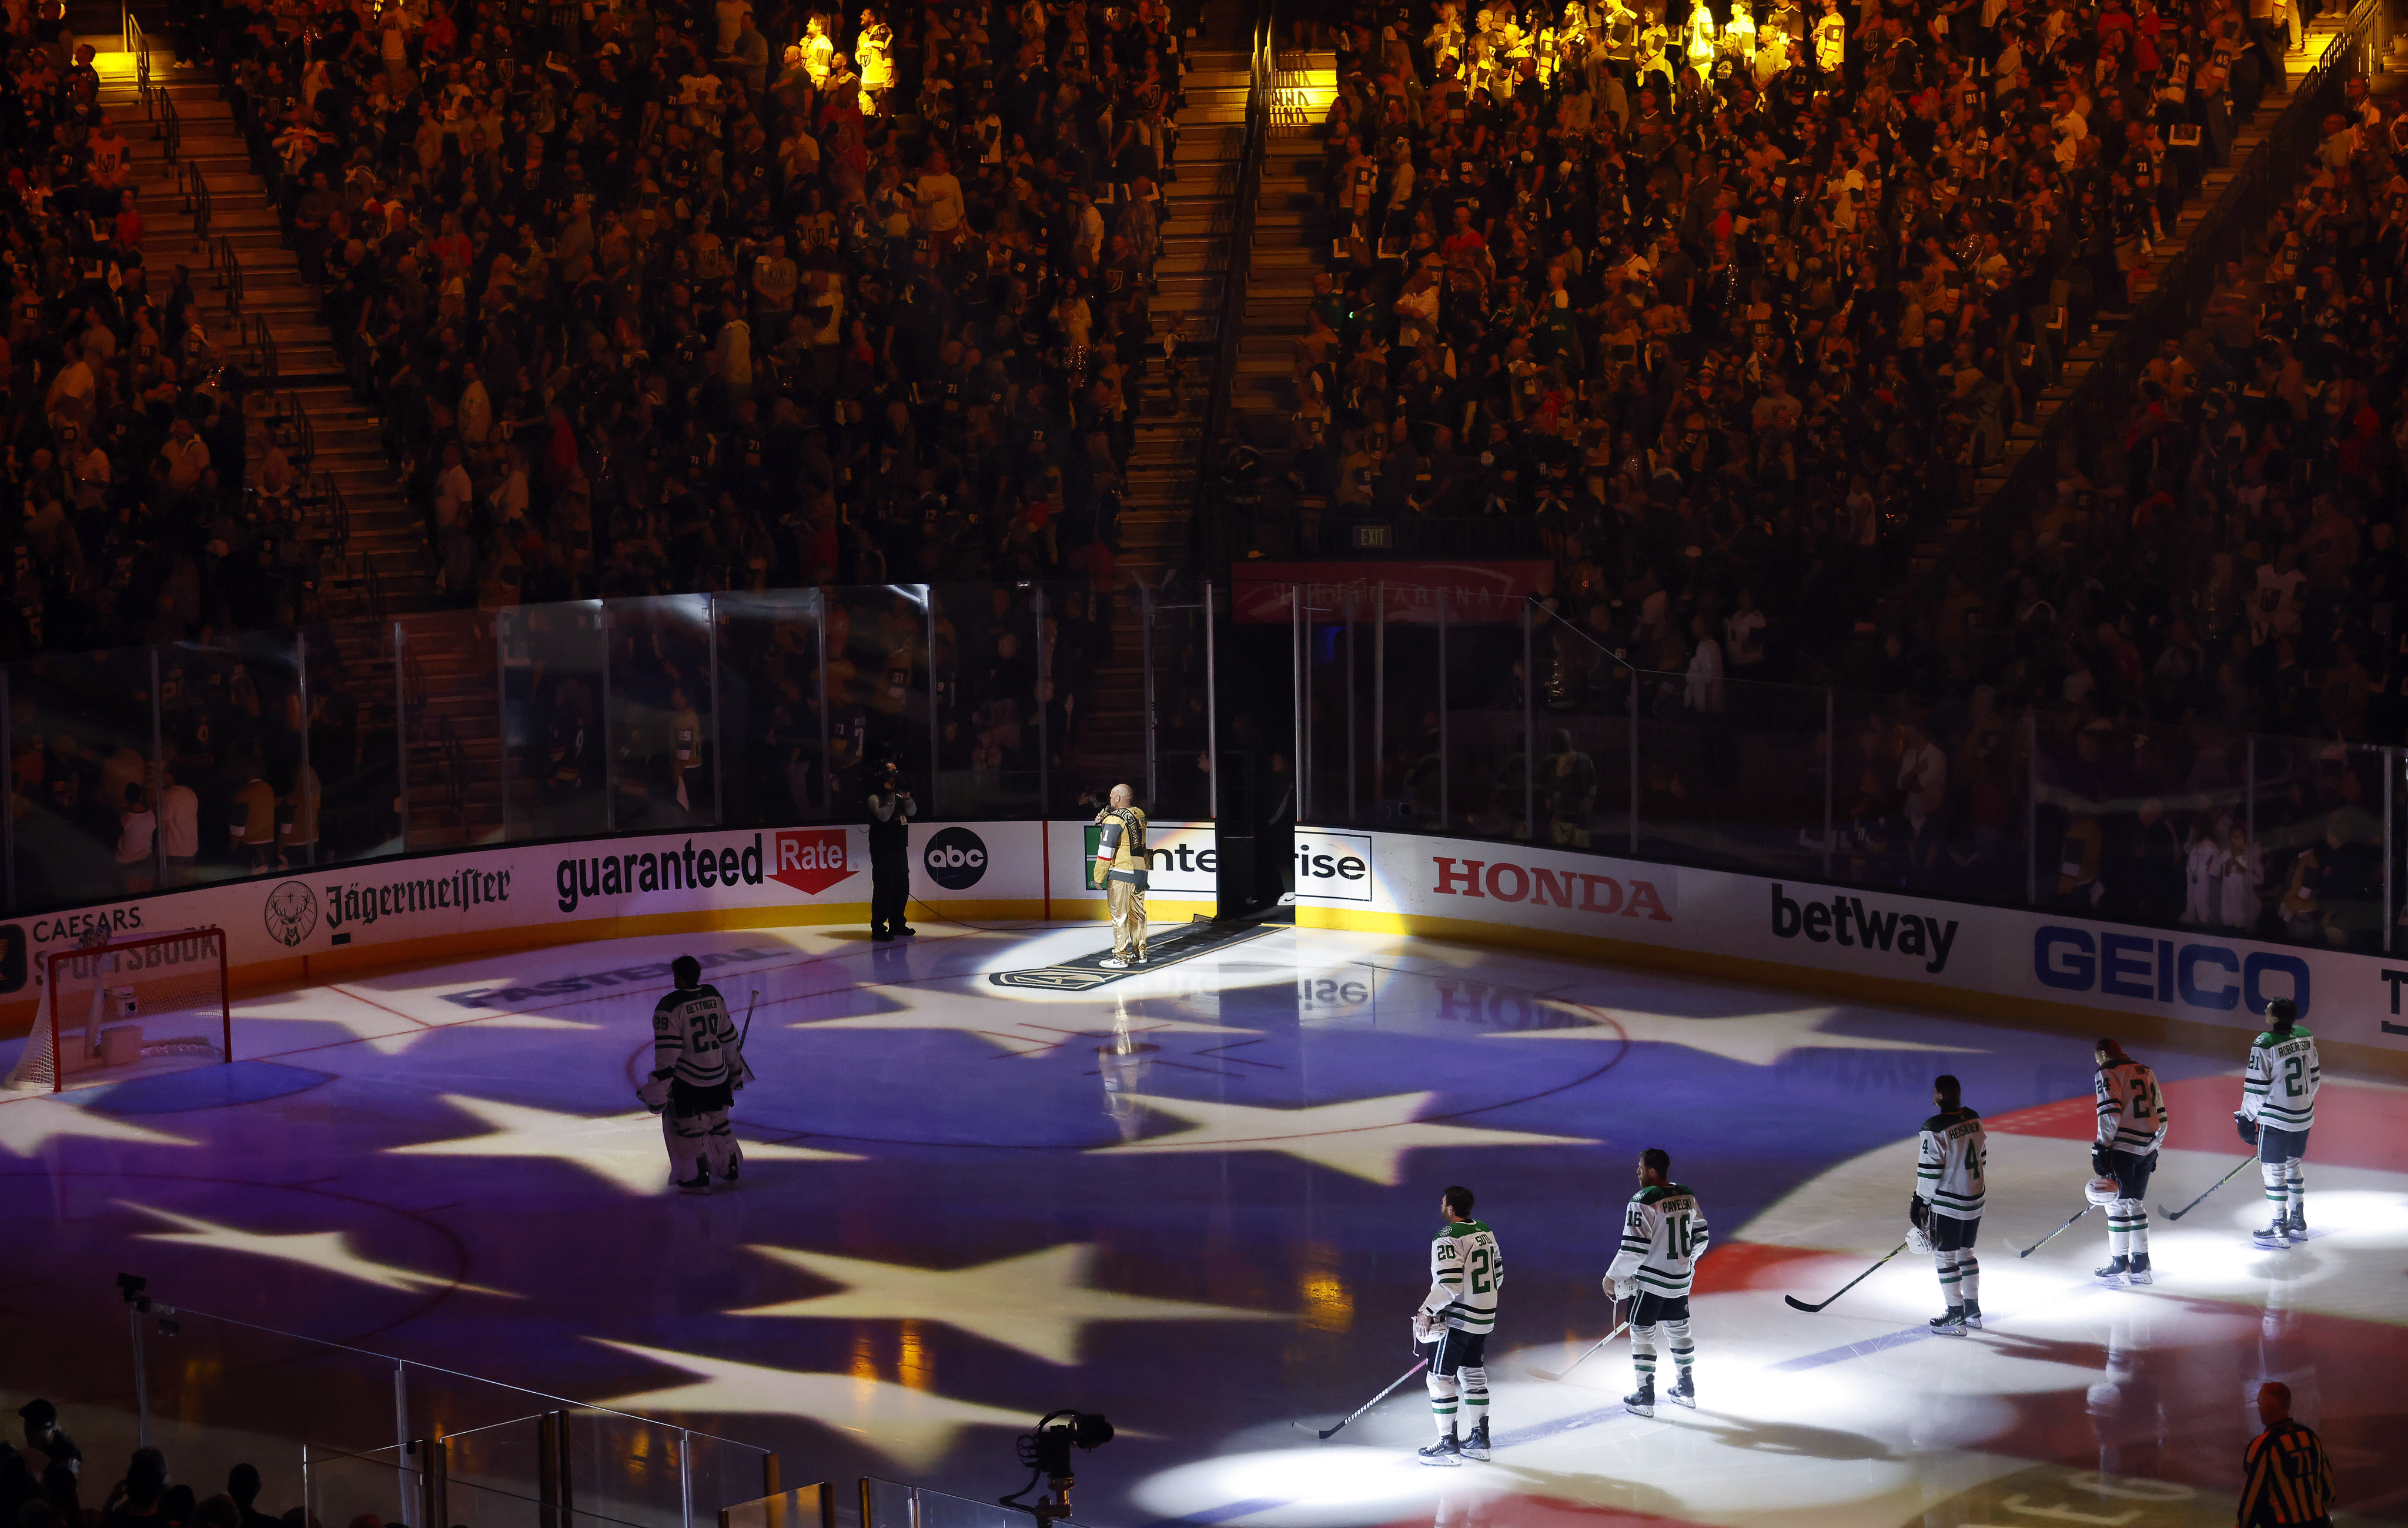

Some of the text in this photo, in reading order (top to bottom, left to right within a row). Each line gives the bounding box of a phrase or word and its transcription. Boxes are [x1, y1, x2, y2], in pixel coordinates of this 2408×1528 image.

[1399, 8, 1409, 18] 71
[1832, 29, 1840, 39] 2
[2216, 54, 2229, 65] 45
[1795, 75, 1806, 84] 22
[668, 96, 676, 105] 71
[62, 155, 72, 165] 71
[2138, 162, 2147, 172] 71
[1530, 212, 1537, 221] 71
[917, 239, 927, 249] 71
[684, 351, 693, 361] 71
[948, 384, 957, 394] 71
[2226, 382, 2237, 392] 71
[749, 440, 760, 450] 71
[691, 456, 698, 464] 71
[1361, 528, 1384, 546] EXIT
[1393, 586, 1491, 605] ARENA
[1131, 824, 1139, 845] BORN
[928, 845, 984, 868] abc
[1145, 844, 1216, 872] nte
[557, 833, 843, 913] guaranteed Rate
[1433, 856, 1673, 922] HONDA
[34, 907, 142, 942] CAESARS
[1771, 883, 1959, 974] betway
[437, 947, 792, 1009] FASTEAL
[2034, 925, 2310, 1020] GEICO
[654, 1016, 669, 1031] 29
[690, 1013, 720, 1054] 29
[2278, 1040, 2310, 1058] ROBERTSON
[2248, 1055, 2260, 1071] 21
[2096, 1078, 2111, 1094] 24
[1922, 1139, 1929, 1154] 4
[1964, 1138, 1981, 1180] 4
[1662, 1198, 1692, 1213] PAVELSKI
[1627, 1211, 1643, 1228] 16
[1666, 1213, 1692, 1260] 16
[1437, 1245, 1456, 1262] 20
[1344, 1387, 1389, 1425] WARRIOR
